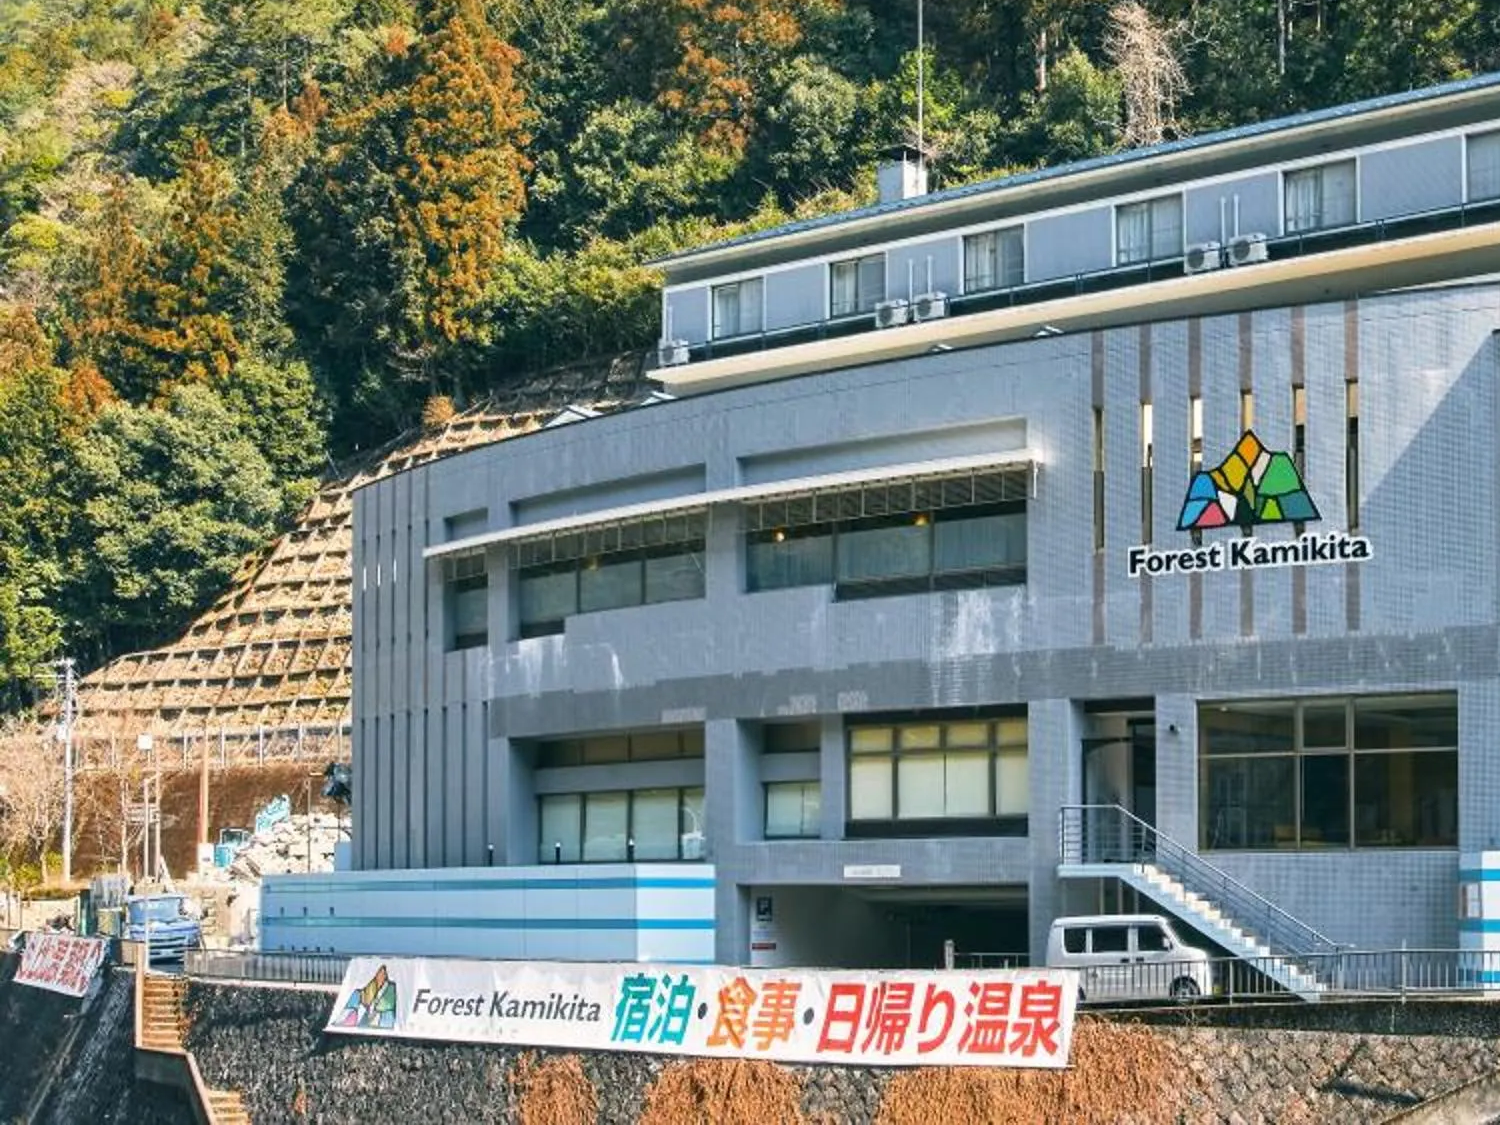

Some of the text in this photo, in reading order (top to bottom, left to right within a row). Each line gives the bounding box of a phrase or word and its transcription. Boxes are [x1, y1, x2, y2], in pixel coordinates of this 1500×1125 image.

[1129, 534, 1370, 574] Forest Kamikita
[412, 988, 601, 1022] Forest Kamikita
